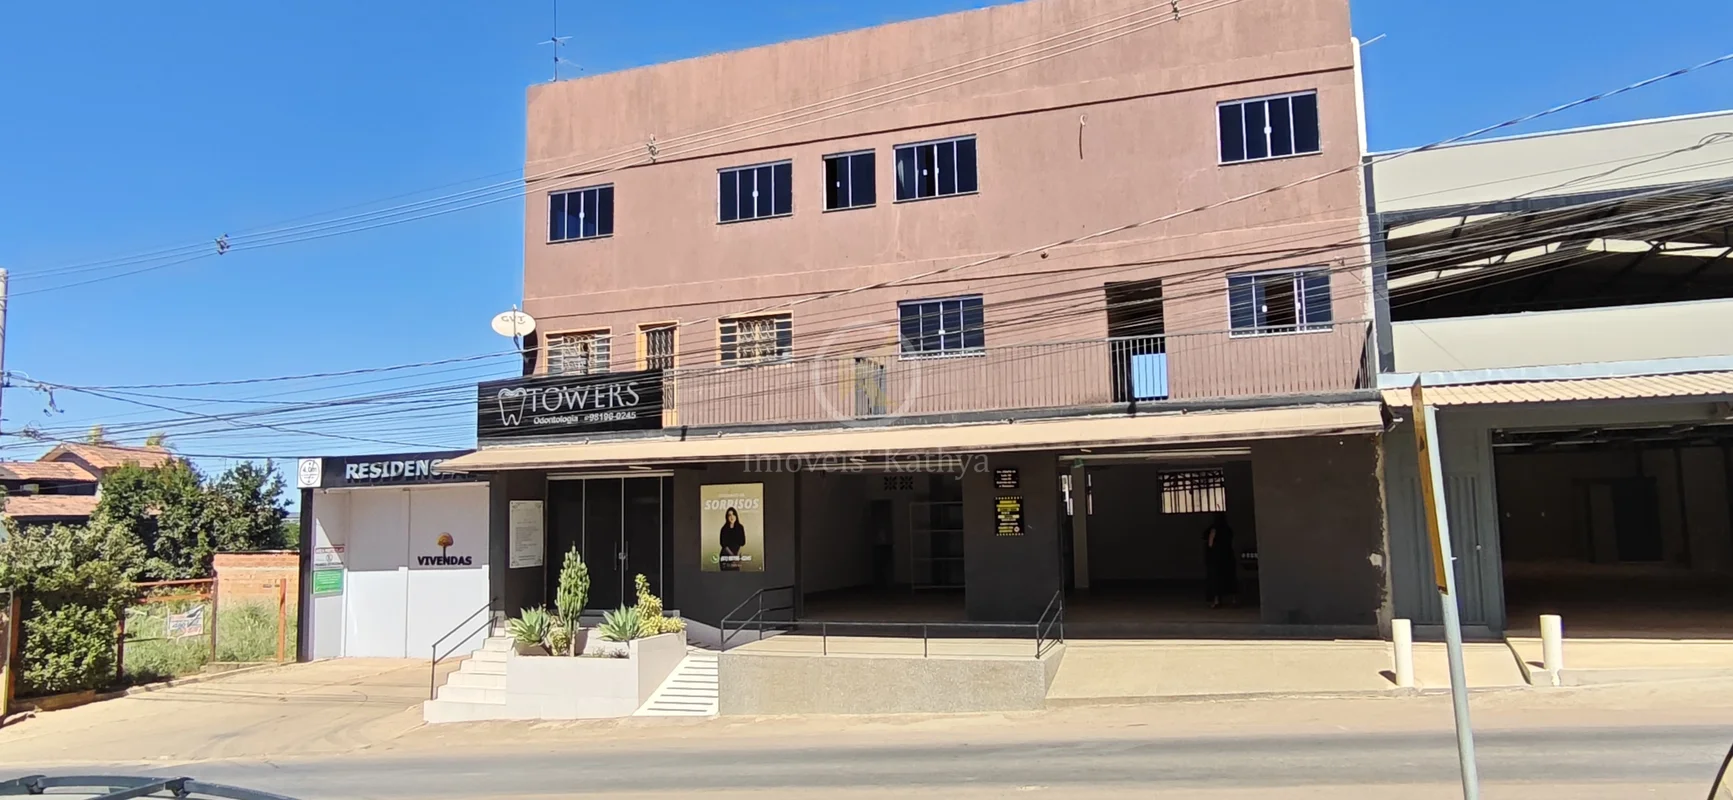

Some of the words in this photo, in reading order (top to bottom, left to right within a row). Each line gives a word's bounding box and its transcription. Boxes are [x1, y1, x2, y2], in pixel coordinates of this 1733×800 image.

[526, 381, 640, 413] TOWERS
[533, 414, 579, 425] Odontologia
[703, 498, 760, 511] SORRISOS
[417, 555, 473, 566] VIVENDAS
